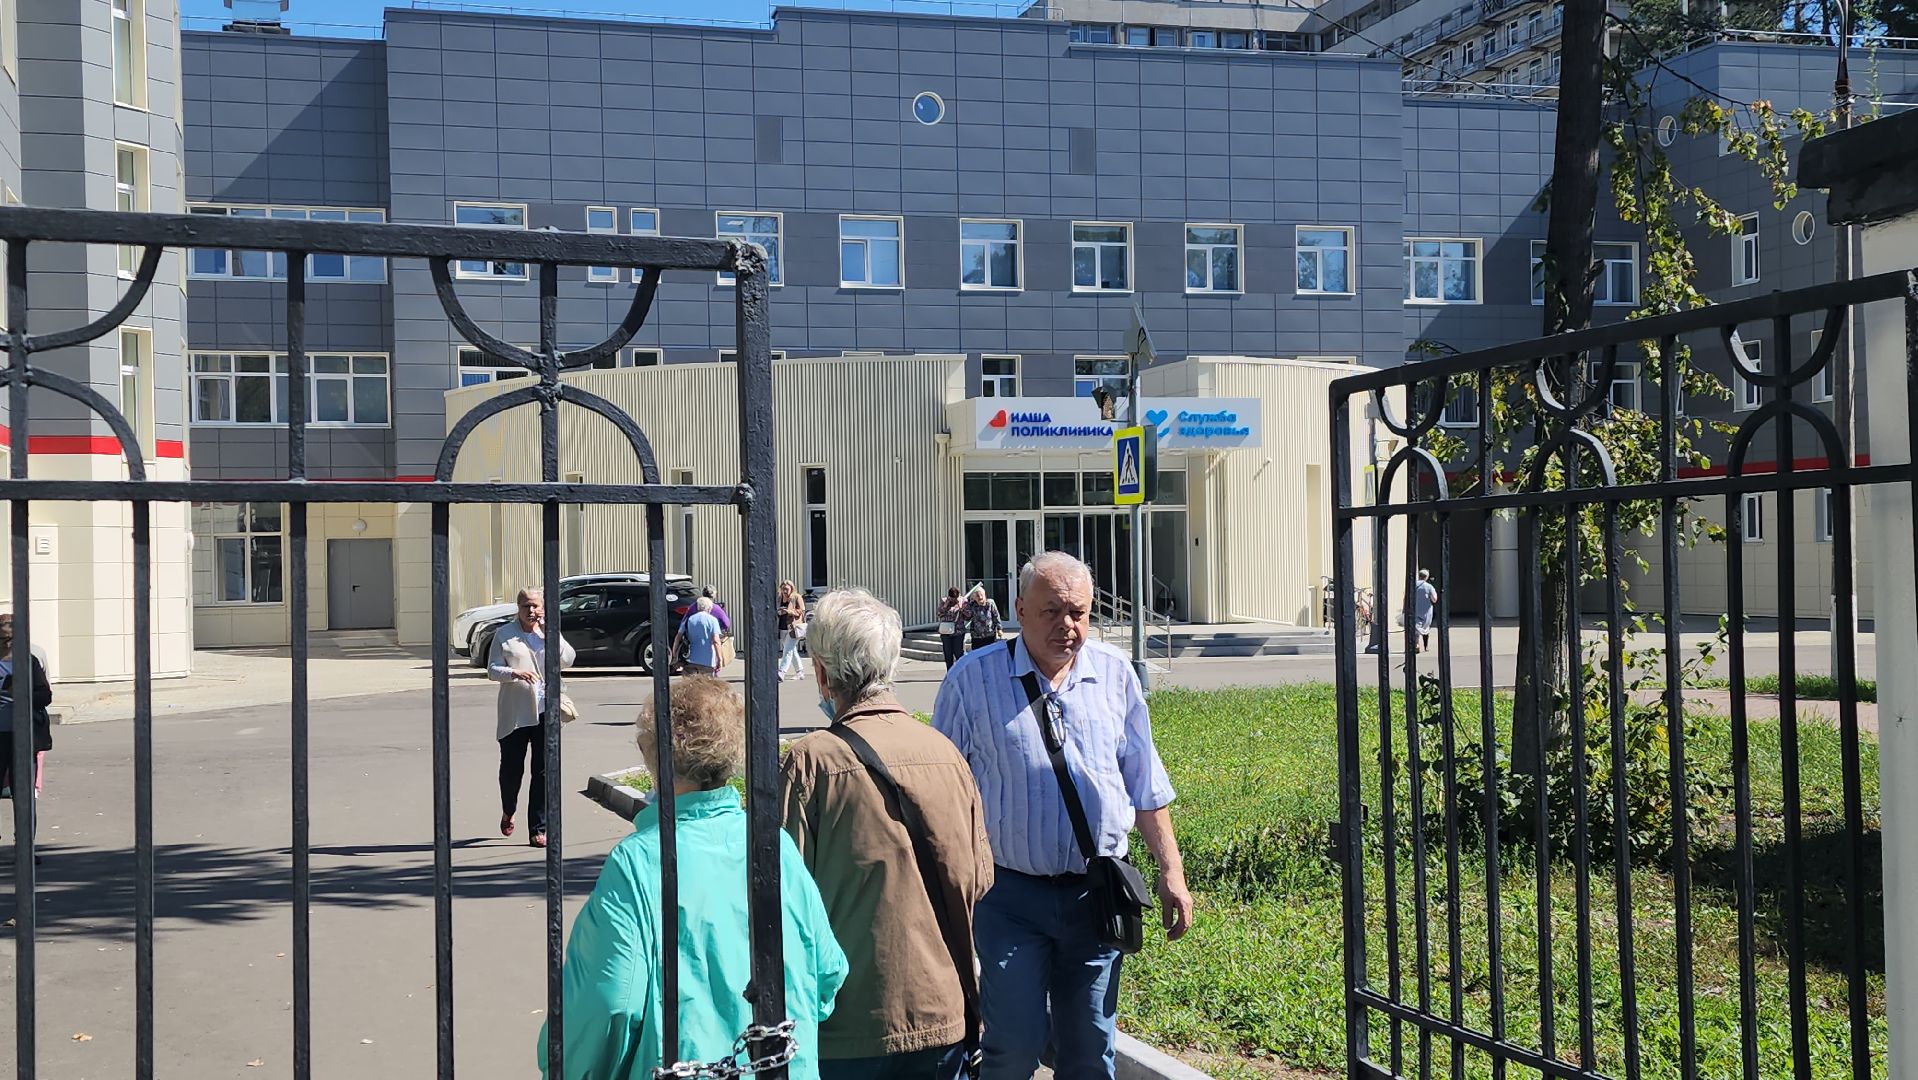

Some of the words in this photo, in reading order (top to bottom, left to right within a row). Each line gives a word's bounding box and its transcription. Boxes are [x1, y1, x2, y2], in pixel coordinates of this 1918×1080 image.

[1011, 412, 1051, 423] НАША
[1178, 410, 1236, 425] Служба
[1011, 426, 1113, 437] ПОЛИКЛИНИКА
[1178, 426, 1249, 438] здоровья
